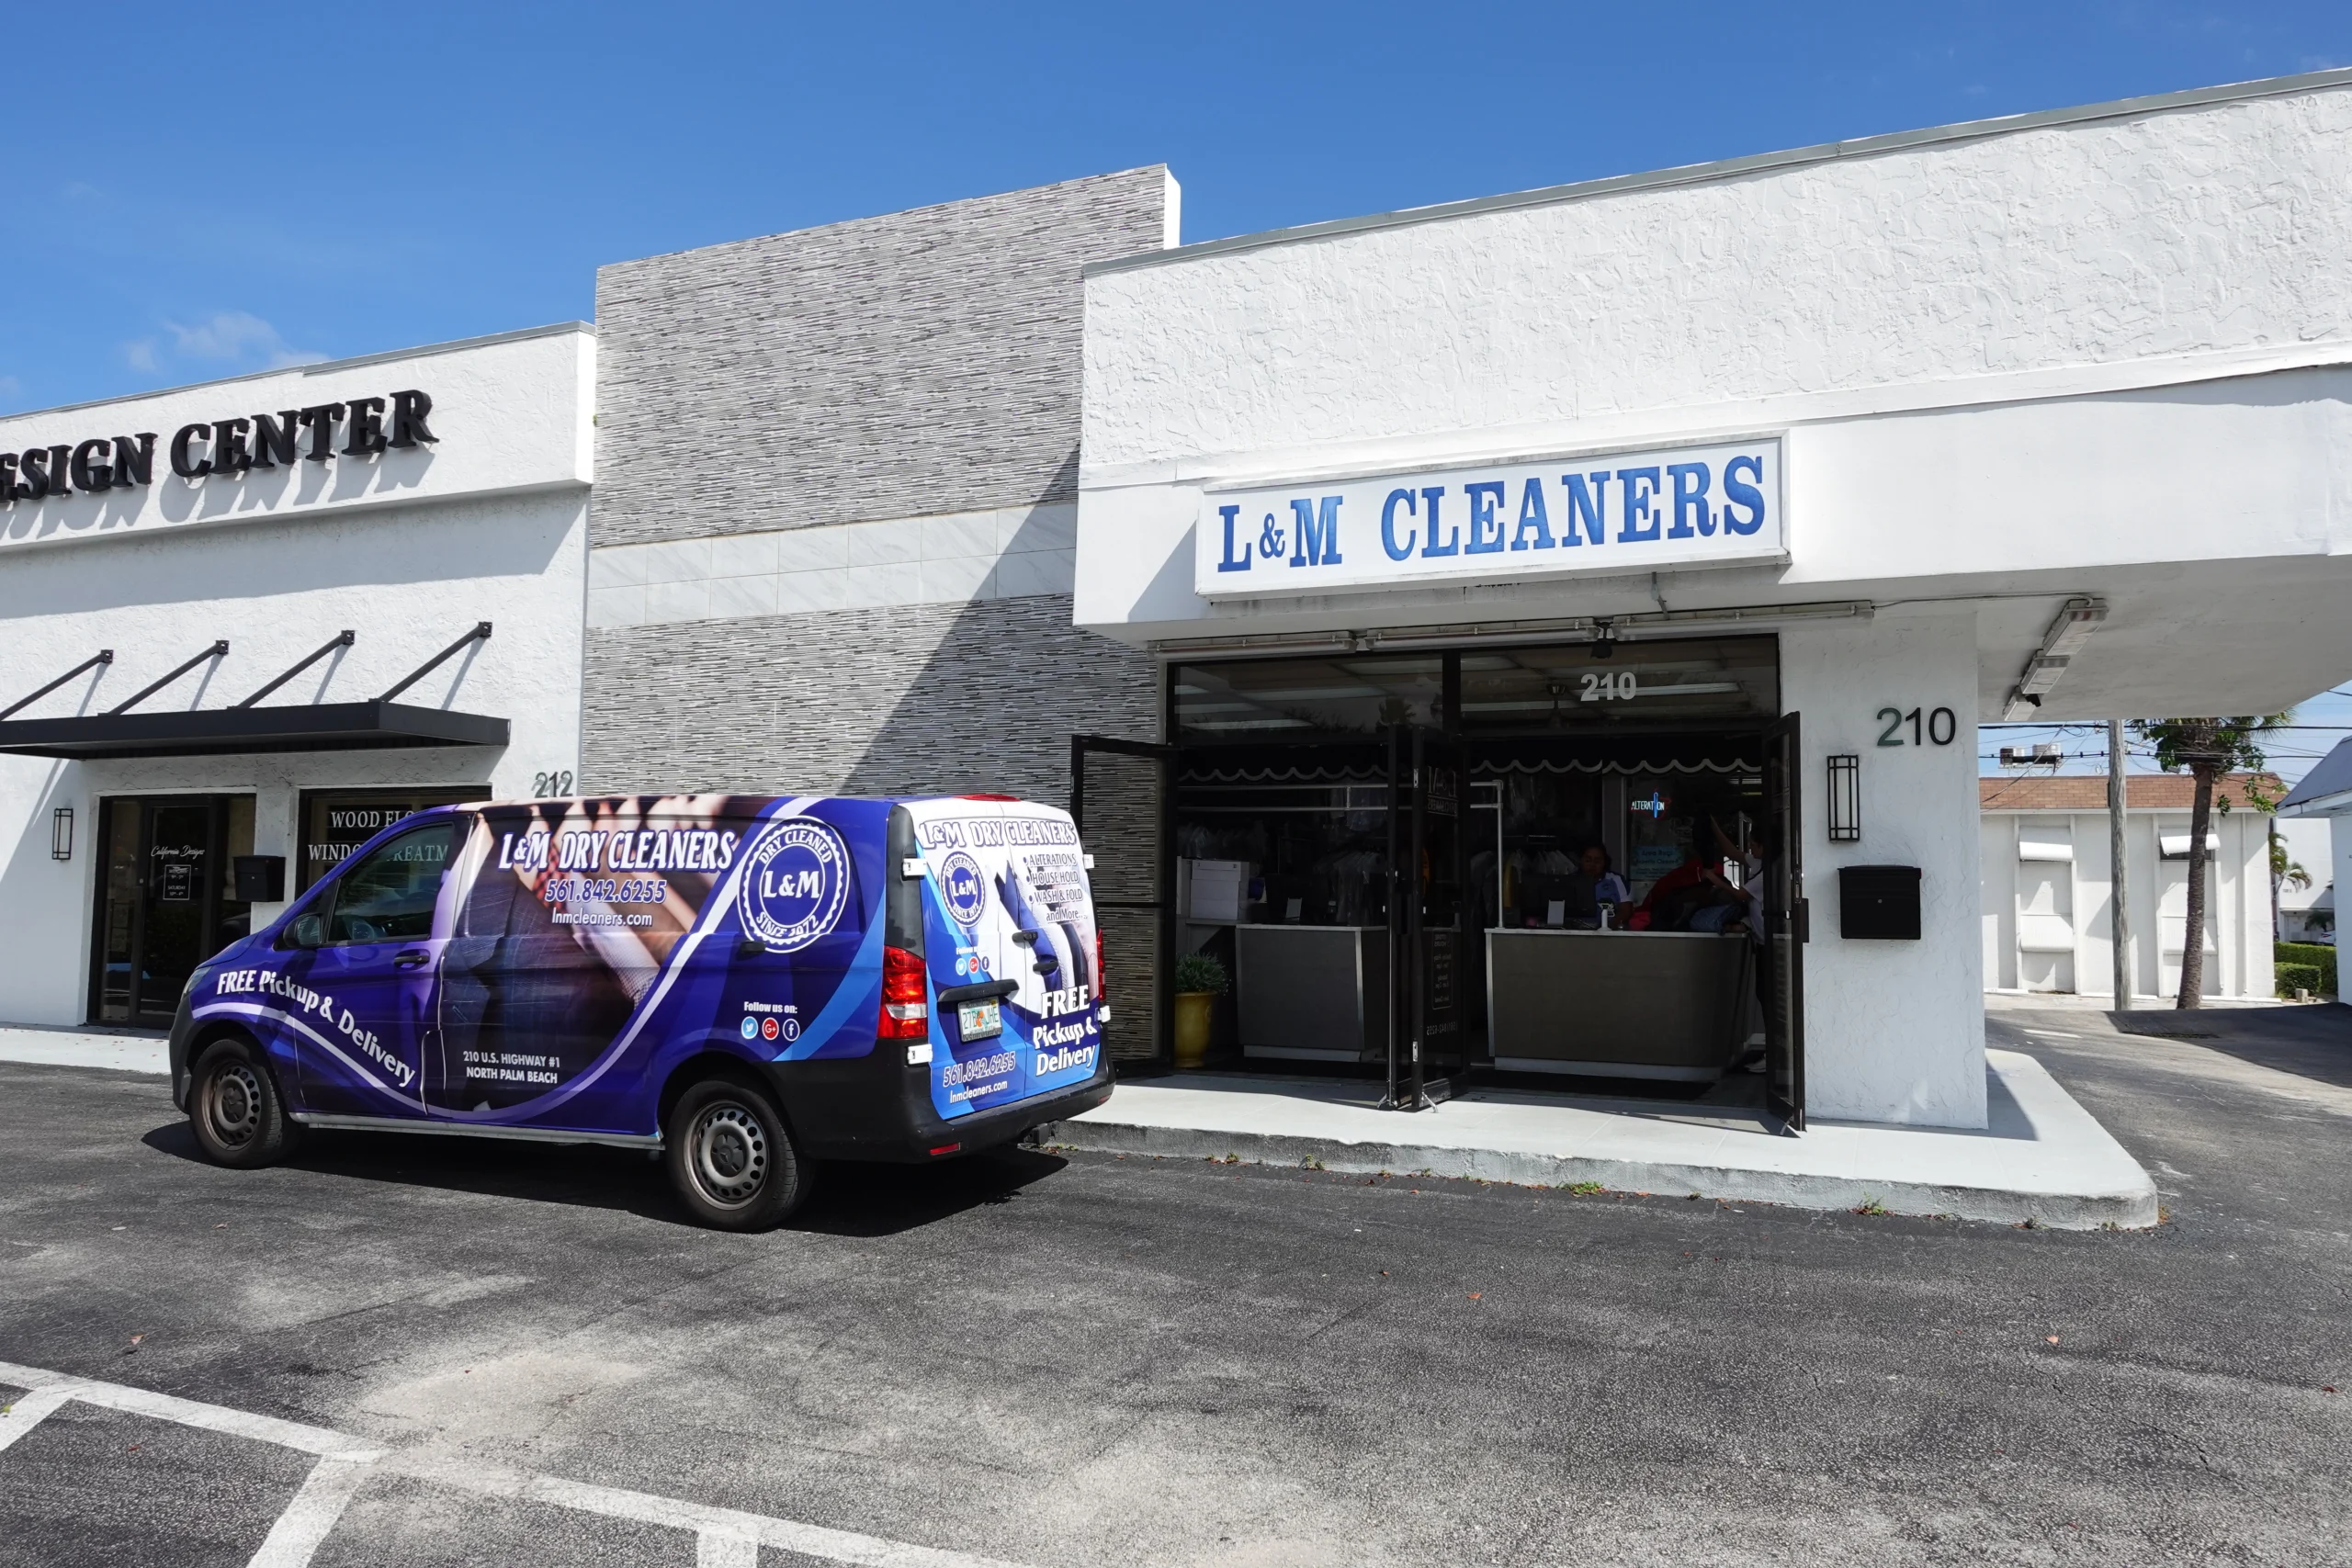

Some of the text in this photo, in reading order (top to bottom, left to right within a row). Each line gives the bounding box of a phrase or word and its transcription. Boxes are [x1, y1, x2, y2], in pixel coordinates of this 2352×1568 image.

[170, 389, 440, 478] CENTER
[1217, 456, 1766, 573] L&M CLEANERS
[1580, 671, 1637, 701] 210
[1876, 707, 1956, 746] 210
[535, 771, 573, 798] 212
[331, 811, 380, 828] WOOD
[758, 829, 833, 865] DRY CLEANED
[920, 821, 1078, 850] L&M DRY CLEANERS
[498, 829, 737, 873] L&M DRY CLEANERS
[1029, 853, 1077, 866] ALTERATIONS
[763, 870, 820, 898] L&M
[945, 863, 955, 878] DRY
[1033, 872, 1079, 885] HOUSE HOLD
[544, 878, 667, 903] 561.842.6255
[951, 879, 977, 897] L&M
[1035, 889, 1083, 903] WASH & FOLD
[756, 911, 788, 938] SINCE
[1046, 910, 1059, 921] and
[743, 1001, 797, 1014] Follow us on:
[1041, 985, 1091, 1020] FREE
[217, 970, 415, 1088] FREE Pickup & Delivery
[1033, 1016, 1098, 1050] Pickup &
[463, 1051, 560, 1068] 210 U.S. HIGHWAY #1
[943, 1051, 1016, 1088] 561.842.6255
[1035, 1045, 1096, 1077] Delivery
[466, 1066, 558, 1084] NORTH PALM BEACH
